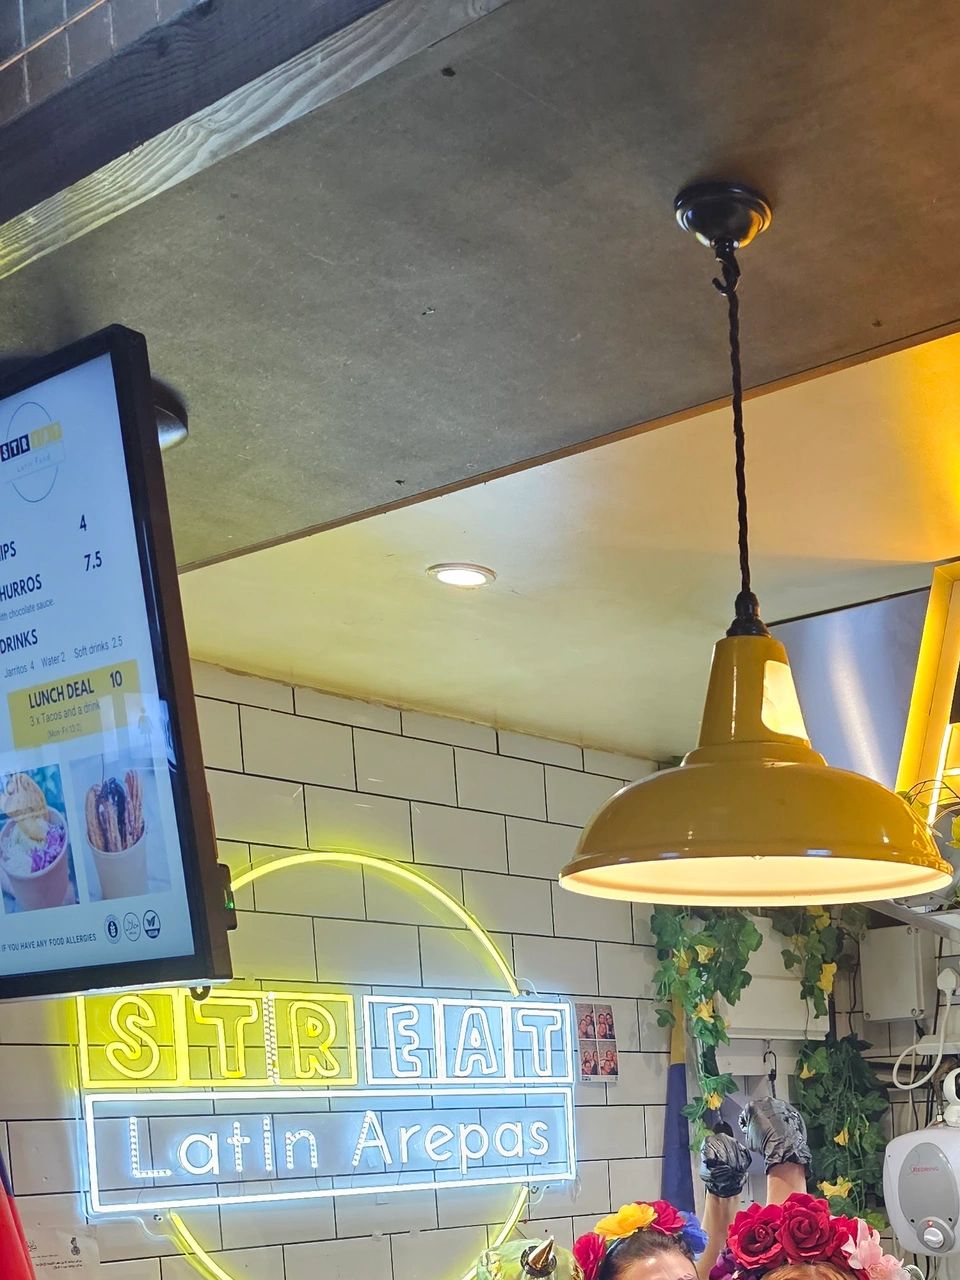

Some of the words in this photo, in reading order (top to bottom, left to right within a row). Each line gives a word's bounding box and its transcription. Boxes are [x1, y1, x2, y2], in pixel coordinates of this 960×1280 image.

[79, 514, 87, 531] 4
[0, 541, 17, 561] IPS
[84, 551, 102, 571] 7.5
[0, 574, 42, 601] HURROS
[0, 629, 38, 655] DRINKS
[41, 655, 60, 669] Water
[73, 646, 88, 659] Soft
[89, 641, 110, 656] drinks
[28, 685, 65, 709] LUNCH
[66, 678, 95, 700] DEAL
[110, 670, 123, 688] 10
[41, 710, 63, 724] Tacos
[63, 704, 77, 719] and
[8, 943, 20, 951] YOU
[20, 940, 36, 950] HAVE
[36, 938, 48, 948] ANY
[48, 937, 65, 947] FOOD
[65, 932, 97, 945] ALLERGIES
[351, 1109, 550, 1175] Arepas
